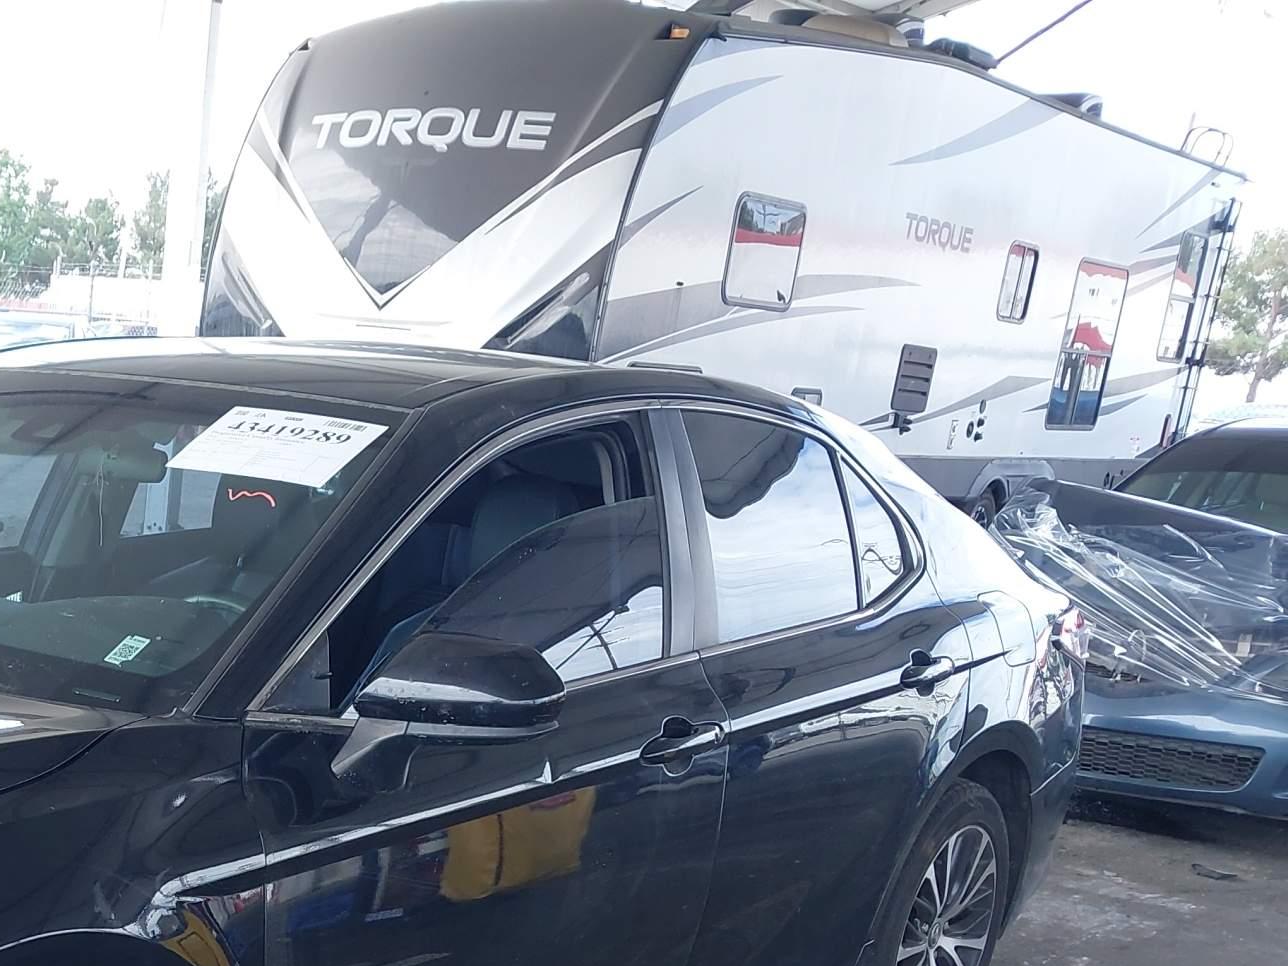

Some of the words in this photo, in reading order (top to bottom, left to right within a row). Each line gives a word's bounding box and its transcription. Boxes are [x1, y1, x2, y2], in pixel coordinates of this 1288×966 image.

[312, 107, 556, 152] TORQUE
[906, 212, 974, 253] TORQUE
[228, 420, 352, 445] 43419289
